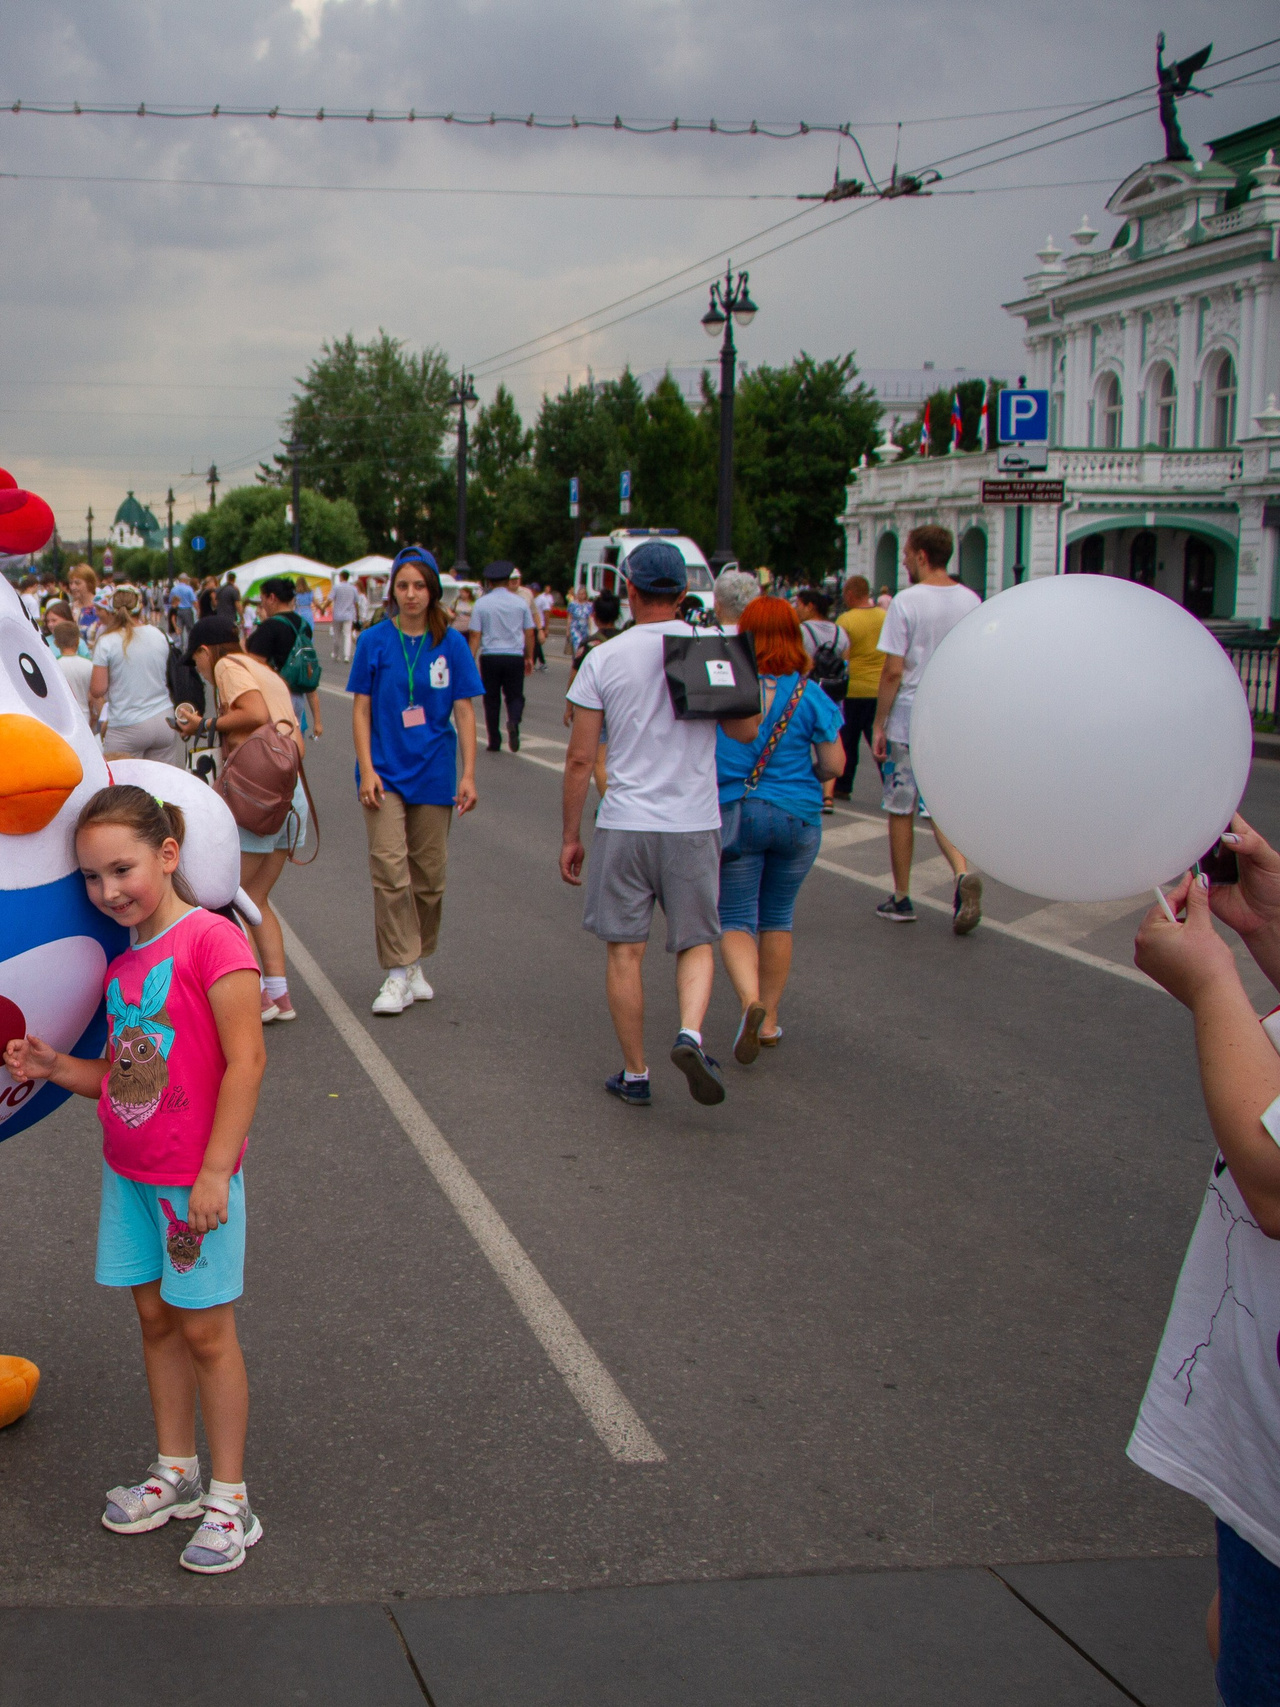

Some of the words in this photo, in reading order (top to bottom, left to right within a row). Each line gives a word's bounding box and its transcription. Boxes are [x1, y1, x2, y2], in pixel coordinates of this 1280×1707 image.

[1010, 395, 1038, 436] P
[1036, 483, 1062, 491] ДРАМЫ
[167, 1091, 190, 1108] like
